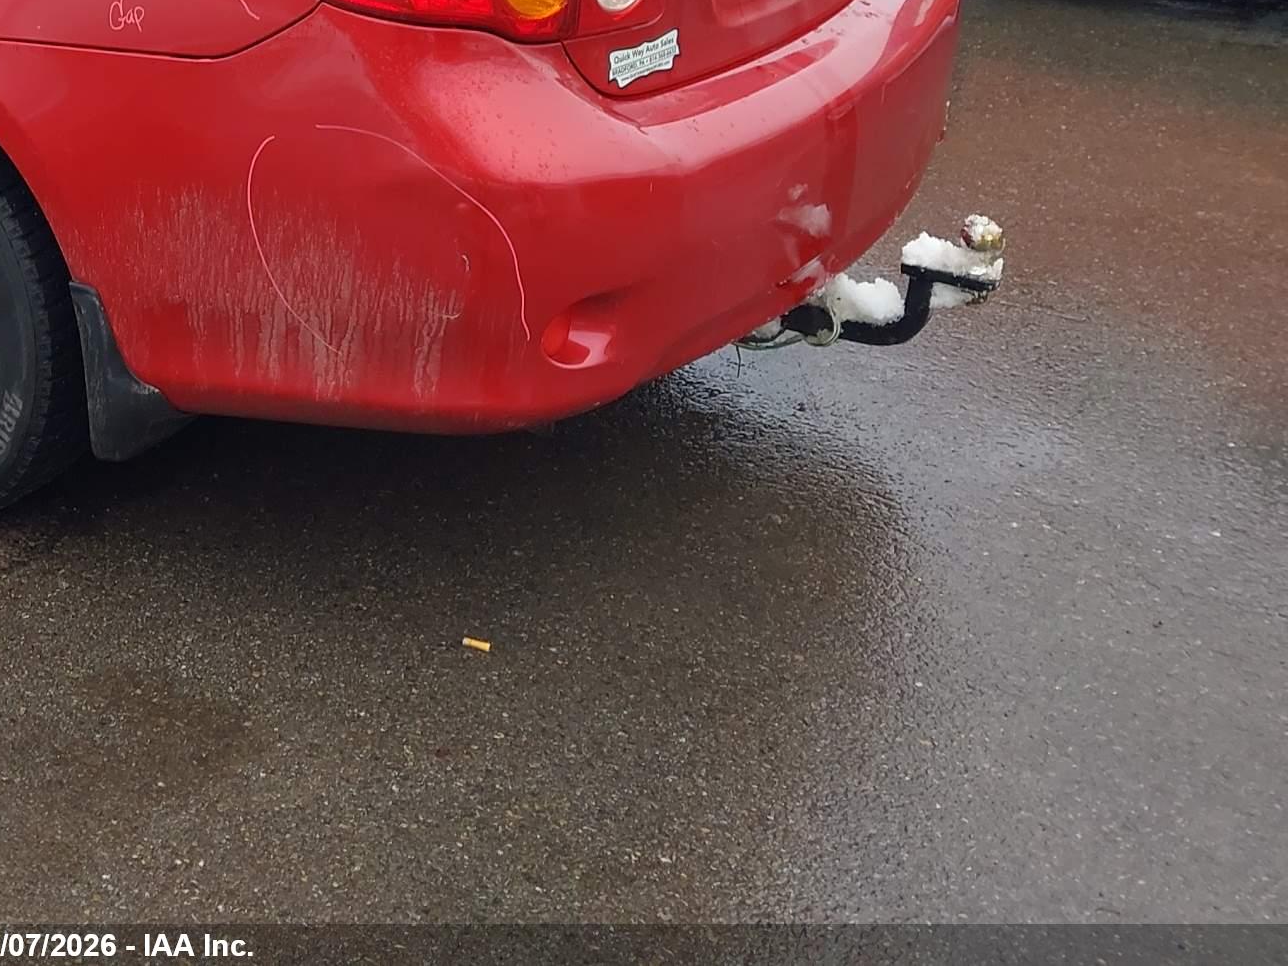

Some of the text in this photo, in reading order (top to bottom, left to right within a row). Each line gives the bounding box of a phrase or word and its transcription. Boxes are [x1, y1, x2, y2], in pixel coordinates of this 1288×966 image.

[614, 51, 630, 64] Quick
[632, 49, 644, 58] Way
[646, 44, 659, 52] Auto
[660, 37, 674, 47] Sales
